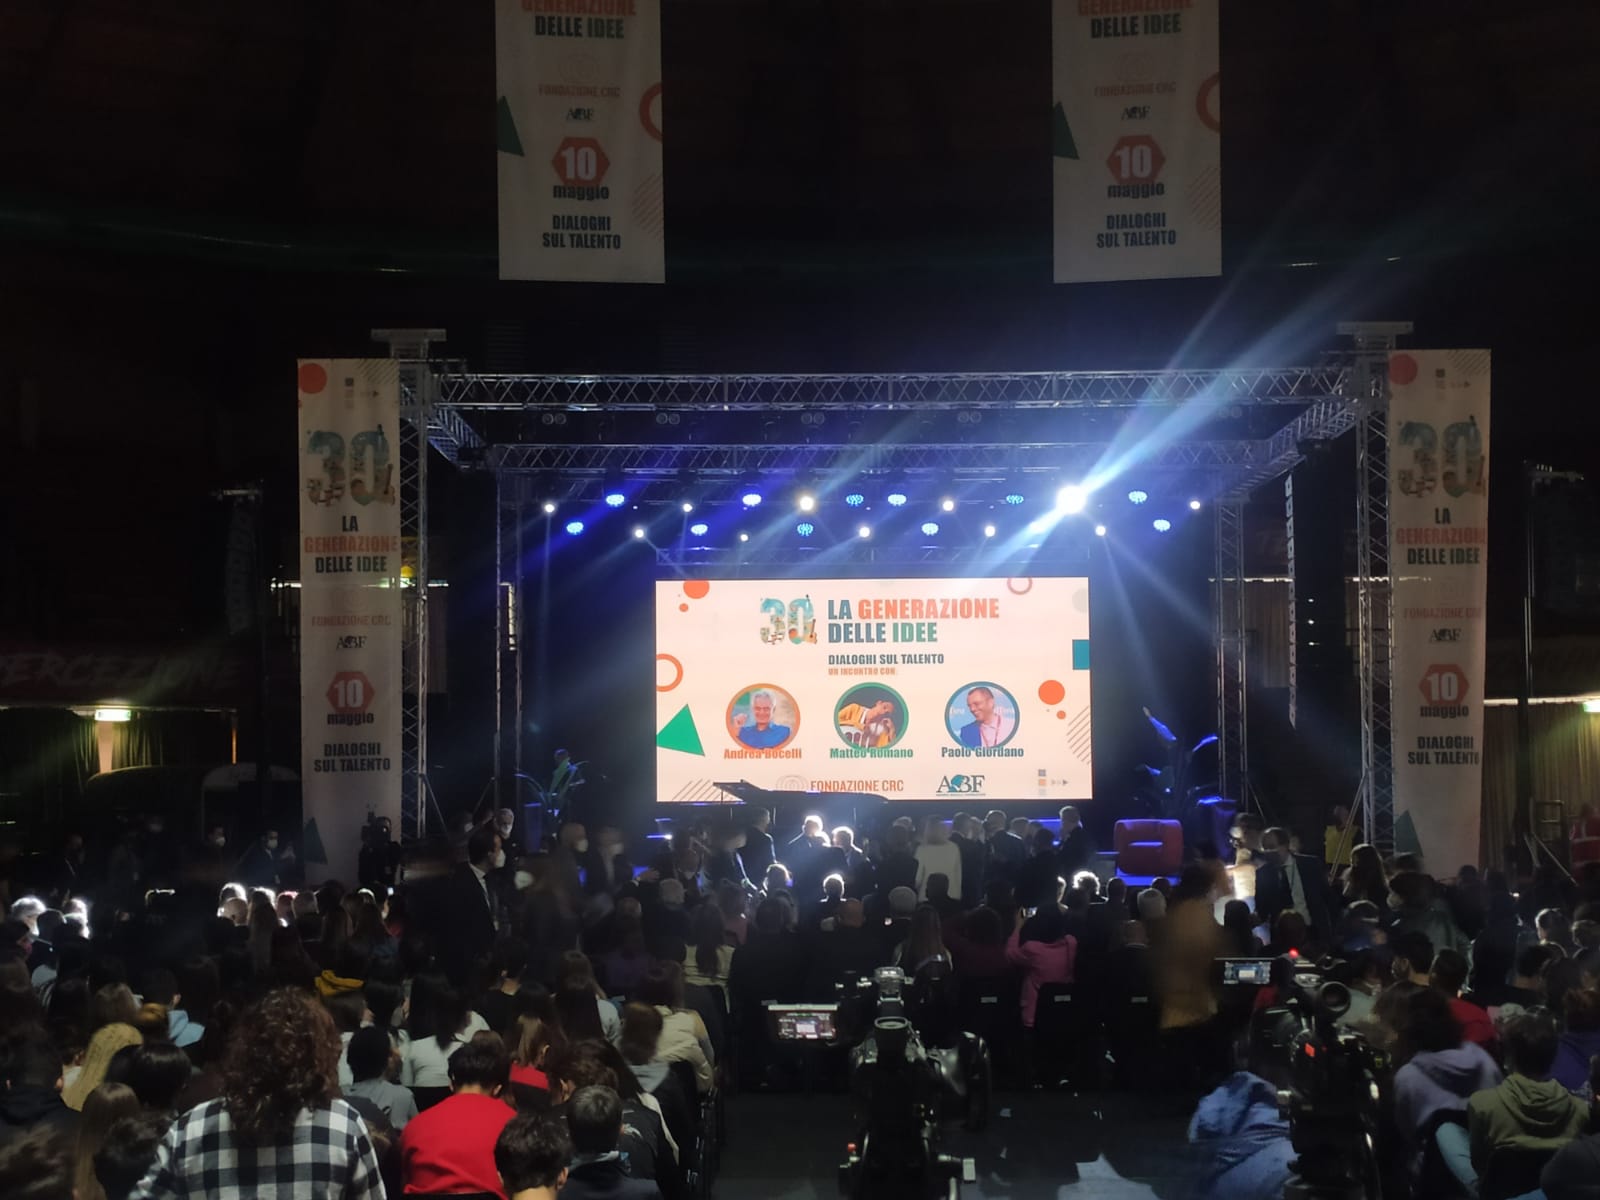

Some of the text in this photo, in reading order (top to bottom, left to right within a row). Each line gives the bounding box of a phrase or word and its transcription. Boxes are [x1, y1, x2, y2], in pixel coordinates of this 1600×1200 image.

[535, 15, 625, 39] DELLE IDEE
[1091, 13, 1181, 38] DELLE IDEE
[561, 146, 597, 181] 10
[1116, 144, 1152, 179] 10
[553, 184, 609, 201] maggio
[1107, 181, 1165, 199] maggio
[552, 215, 611, 231] DIALOGHI
[1106, 212, 1166, 230] DIALOGHI
[542, 231, 621, 249] SUL TALENTO
[1096, 230, 1176, 248] SUL TALENTO
[342, 515, 358, 532] LA
[1435, 507, 1451, 525] LA
[304, 535, 398, 553] GENERAZIONE
[315, 555, 387, 573] DELLE IDEE
[1408, 547, 1480, 564] DELLE IDEE
[828, 598, 1000, 620] LA GENERAZIONE
[828, 622, 938, 644] DELLE IDEE
[828, 653, 945, 665] DIALOGHI SUL TALENTO
[828, 667, 839, 676] UN
[841, 667, 878, 676] INCONTRO
[333, 679, 364, 708] 10
[1426, 671, 1459, 701] 10
[327, 711, 374, 726] maggio
[1420, 704, 1469, 719] maggio
[324, 742, 381, 757] DIALOGHI
[1417, 735, 1474, 750] DIALOGHI
[724, 748, 802, 759] Andrea Bocelli
[830, 748, 914, 759] Matteo Romano
[941, 747, 1024, 758] Paolo Giordano
[1408, 751, 1431, 765] SUL
[314, 758, 391, 773] SUL TALENTO
[811, 780, 904, 792] FONDAZIONE CRC
